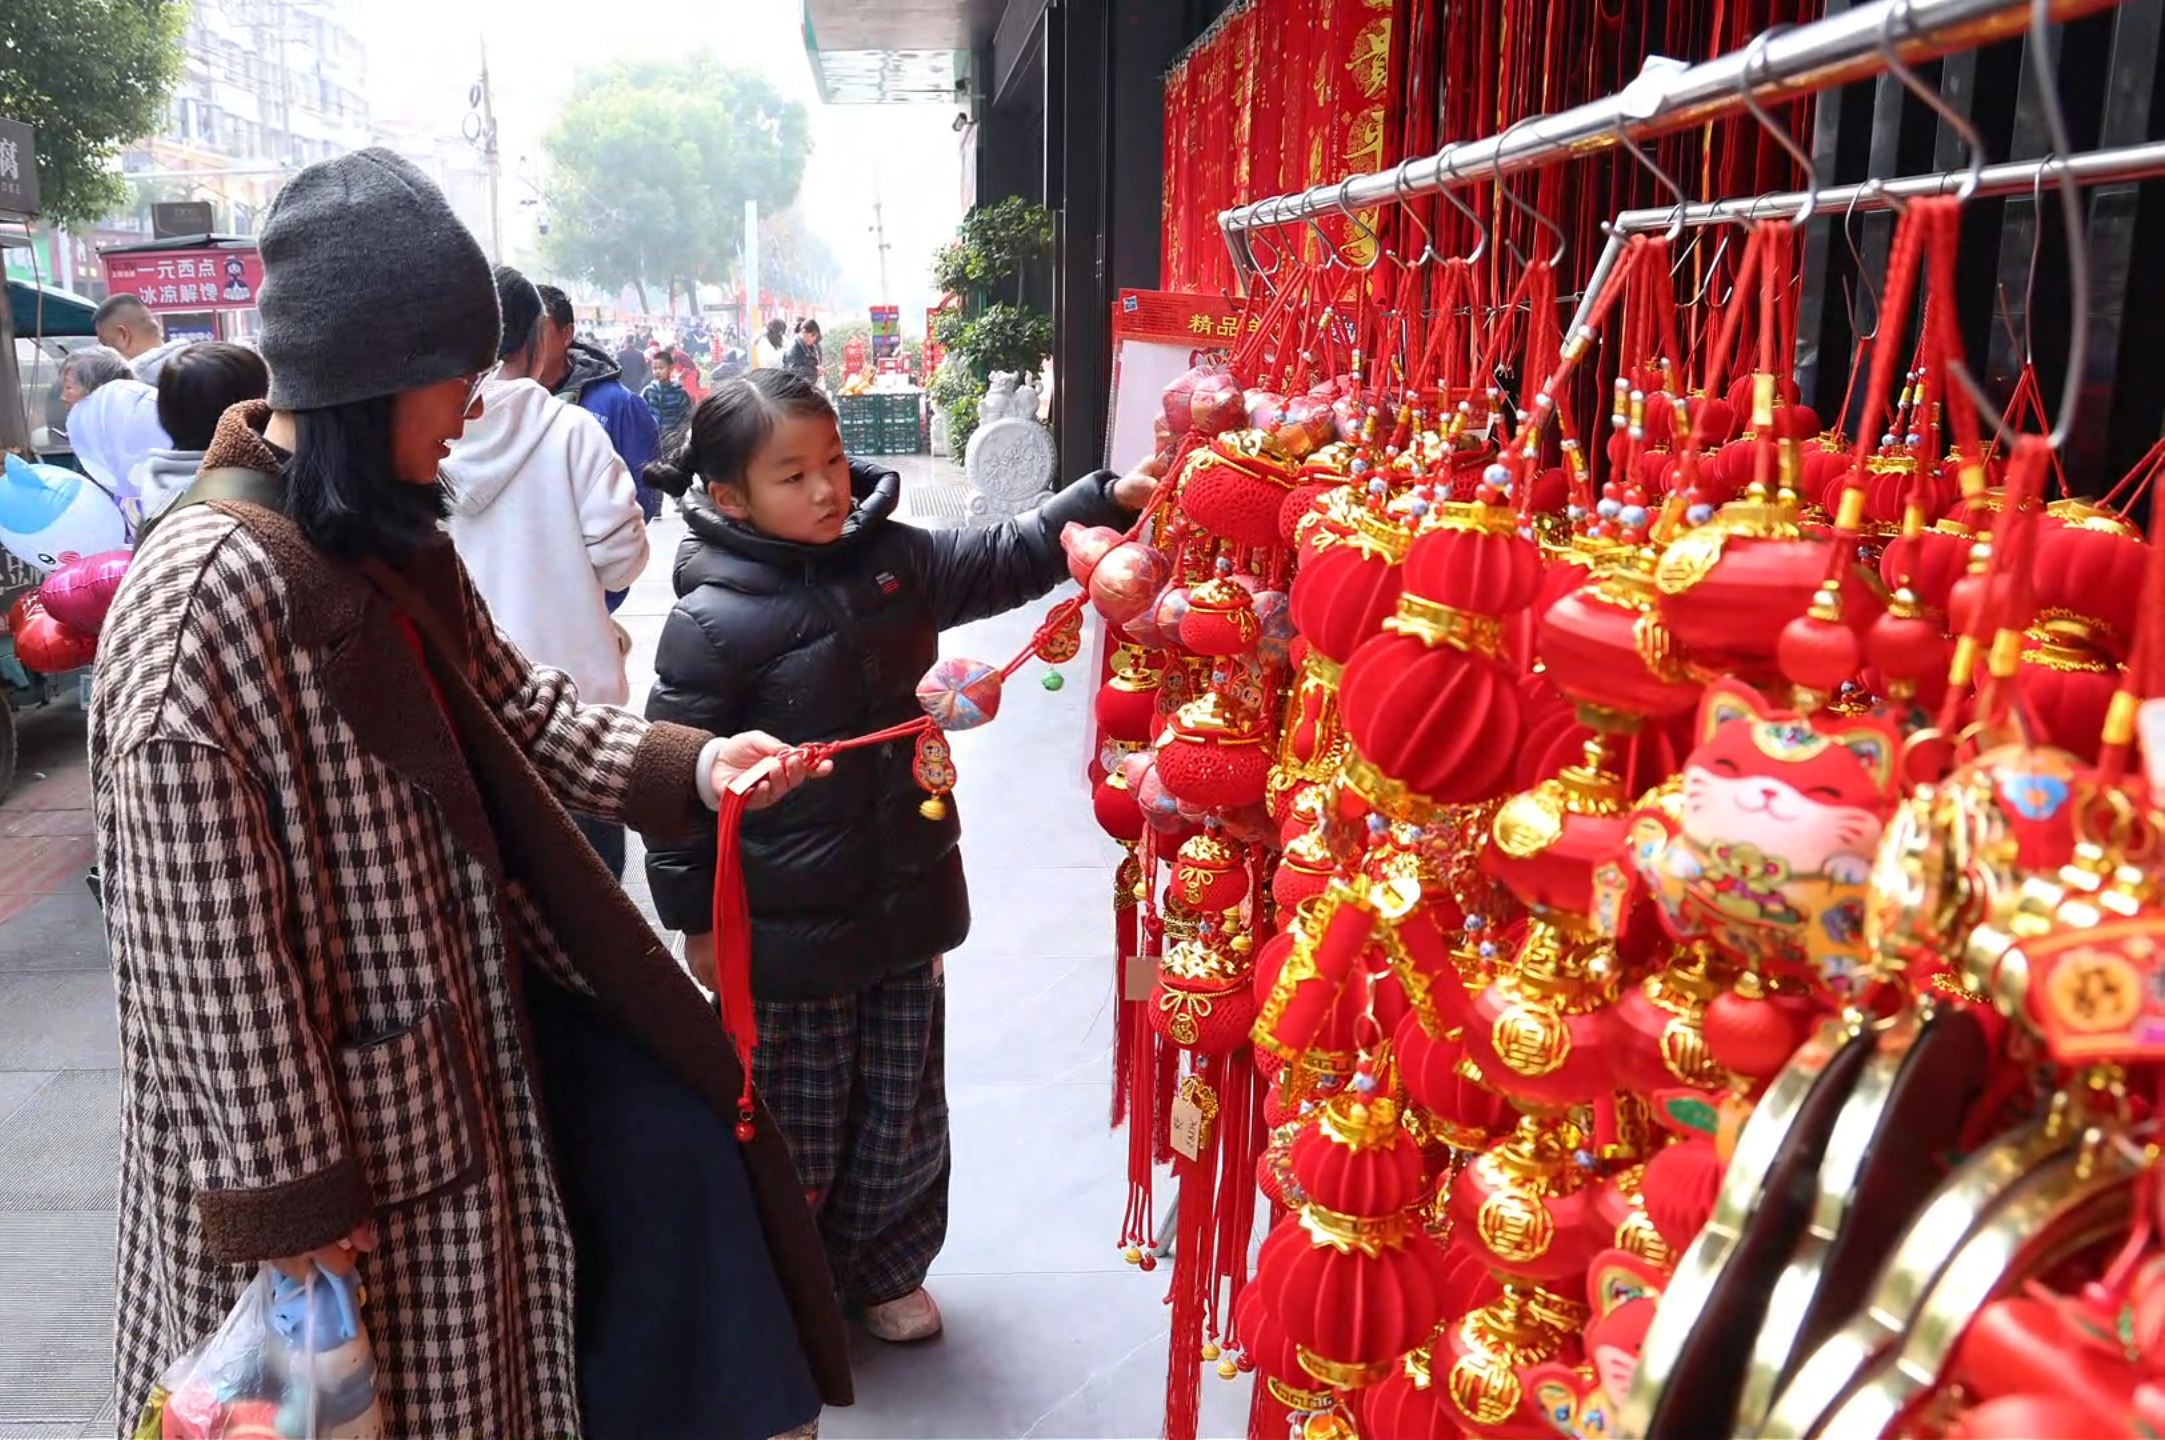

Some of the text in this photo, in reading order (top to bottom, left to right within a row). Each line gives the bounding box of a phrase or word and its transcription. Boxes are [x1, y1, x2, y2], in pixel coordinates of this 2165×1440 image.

[137, 258, 216, 279] 一元西点
[139, 283, 218, 305] 冰凉解馋
